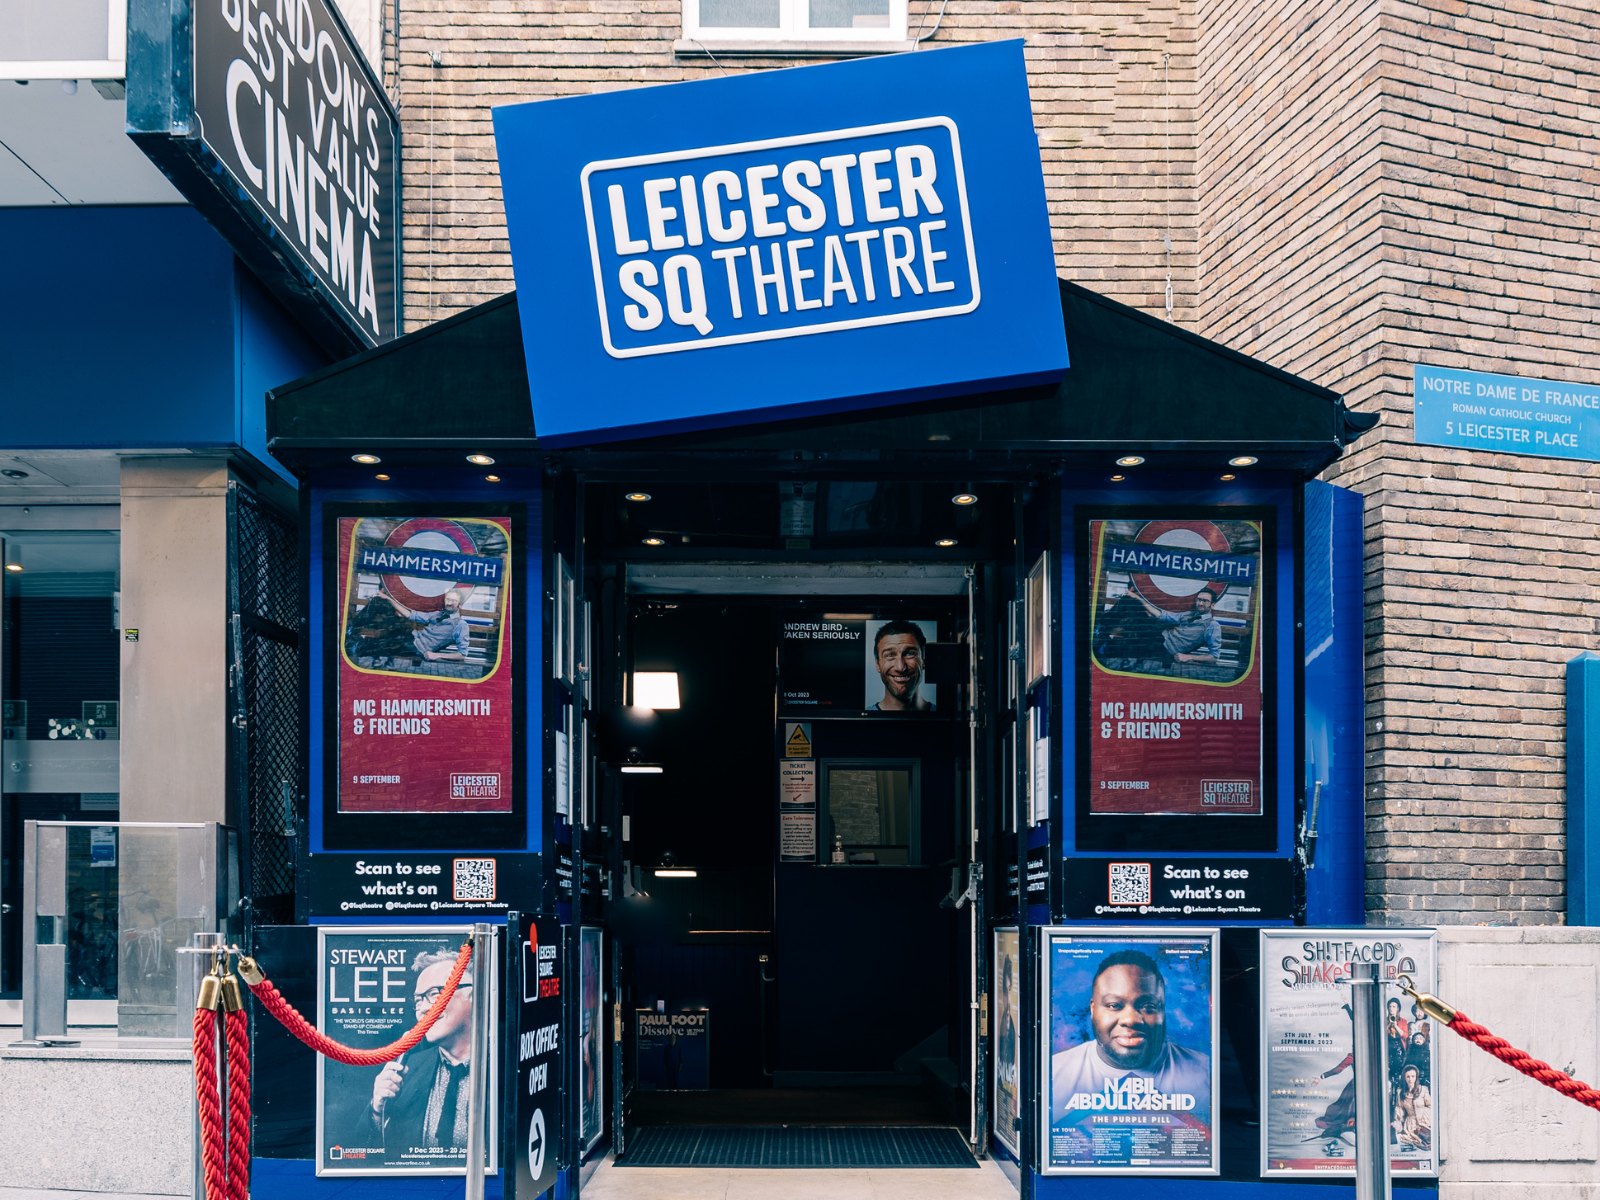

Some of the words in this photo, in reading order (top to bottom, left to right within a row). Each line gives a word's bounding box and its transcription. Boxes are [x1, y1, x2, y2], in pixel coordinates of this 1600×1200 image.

[307, 77, 380, 239] VALUE
[226, 59, 380, 336] CINEMA
[607, 145, 943, 255] LEICESTER
[618, 253, 714, 335] SQ
[712, 220, 955, 319] THEATRE
[1423, 377, 1471, 395] NOTRE
[1476, 383, 1516, 401] DAME
[1522, 388, 1540, 403] DE
[1545, 391, 1600, 409] FRANCE
[1452, 403, 1486, 416] ROMAN
[1489, 407, 1533, 420] CATHOLIC
[1535, 412, 1571, 424] CHURCH
[1446, 421, 1454, 435] 5
[1458, 422, 1530, 443] LEICESTER
[1535, 430, 1578, 447] PLACE
[363, 551, 497, 578] HAMMERSMITH
[1112, 548, 1250, 578] HAMMERSMITH
[812, 631, 860, 640] SERIOUSLY
[822, 623, 843, 631] BIRD
[353, 699, 376, 716] MC
[381, 699, 490, 716] HAMMERSMITH
[1101, 702, 1125, 720] MC
[1130, 702, 1243, 720] HAMMERSMITH
[353, 718, 364, 735] &
[369, 718, 431, 735] FRIENDS
[1101, 721, 1112, 739] &
[1117, 721, 1181, 739] FRIENDS
[353, 775, 358, 783] 9
[360, 775, 401, 783] SEPTEMBER
[453, 775, 497, 786] LEICESTER
[1100, 781, 1106, 790] 9
[1107, 781, 1150, 790] SEPTEMBER
[1204, 782, 1250, 793] LEICESTER
[453, 786, 465, 797] SQ
[466, 786, 498, 797] THEATRE
[1204, 793, 1216, 804] SQ
[1216, 793, 1250, 804] THEATRE
[355, 861, 392, 874] Scan
[395, 862, 412, 874] to
[415, 864, 442, 874] see
[1163, 865, 1201, 879] Scan
[1203, 866, 1220, 879] to
[1223, 868, 1249, 879] see
[361, 881, 414, 895] what's
[417, 884, 438, 895] on
[1170, 885, 1222, 899] what's
[1225, 888, 1246, 899] on
[464, 902, 485, 910] Square
[1217, 906, 1238, 914] Square
[330, 949, 407, 965] STEWART
[330, 967, 406, 1003] LEE
[639, 1015, 669, 1025] PAUL
[671, 1015, 705, 1025] FOOT
[640, 1025, 684, 1036] Dissolve
[520, 1030, 535, 1062] BOX
[535, 1023, 559, 1056] OFFICE
[529, 1062, 548, 1096] OPEN
[1104, 1077, 1159, 1094] NABIL
[1064, 1092, 1196, 1110] ABDULRASHID
